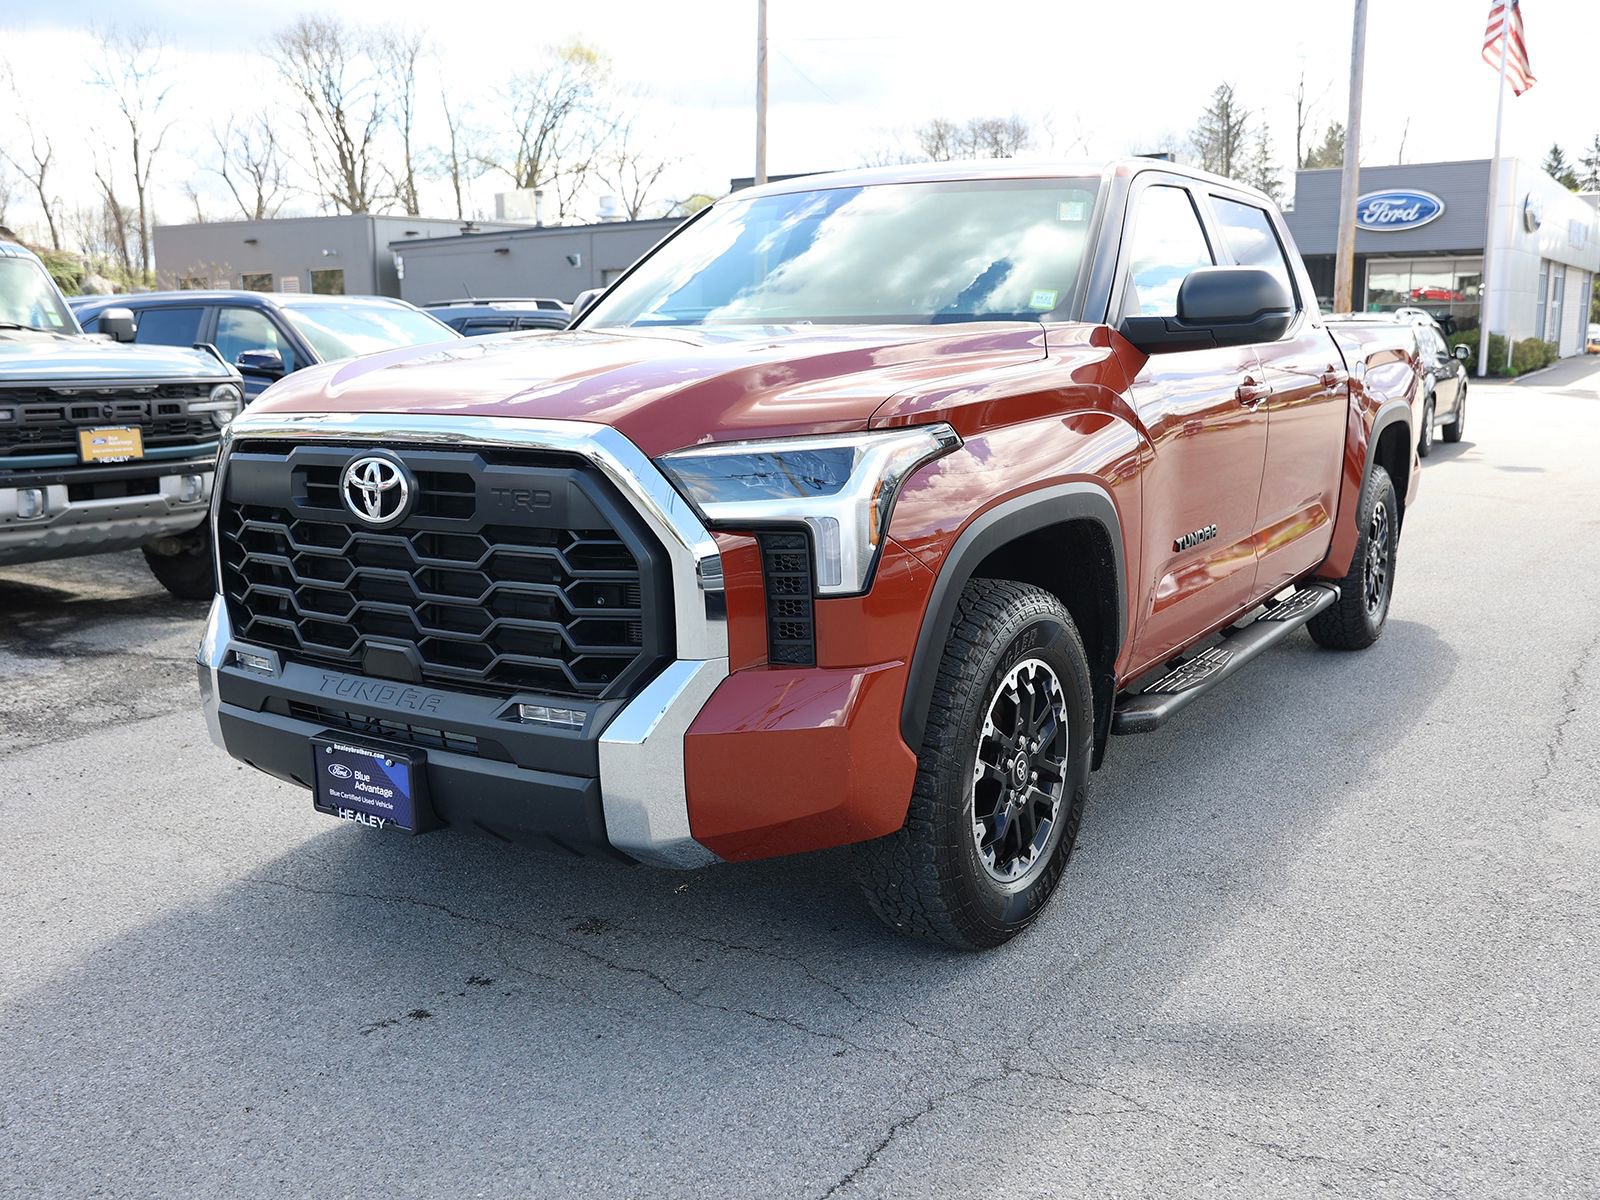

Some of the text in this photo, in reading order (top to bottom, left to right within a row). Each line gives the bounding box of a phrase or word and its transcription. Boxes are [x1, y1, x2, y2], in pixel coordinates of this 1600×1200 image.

[1362, 199, 1420, 224] Ford
[17, 399, 188, 426] FORD
[99, 456, 130, 464] HEALEY
[490, 487, 553, 513] TRD
[1174, 523, 1217, 553] TUNDRA
[320, 674, 445, 713] TUNDRA
[333, 743, 385, 760] healeybrothers.com
[354, 770, 371, 782] Blue
[329, 788, 394, 810] Blue Certified Used Vehicle
[354, 781, 393, 799] Advantage
[338, 807, 386, 829] HEALEY
